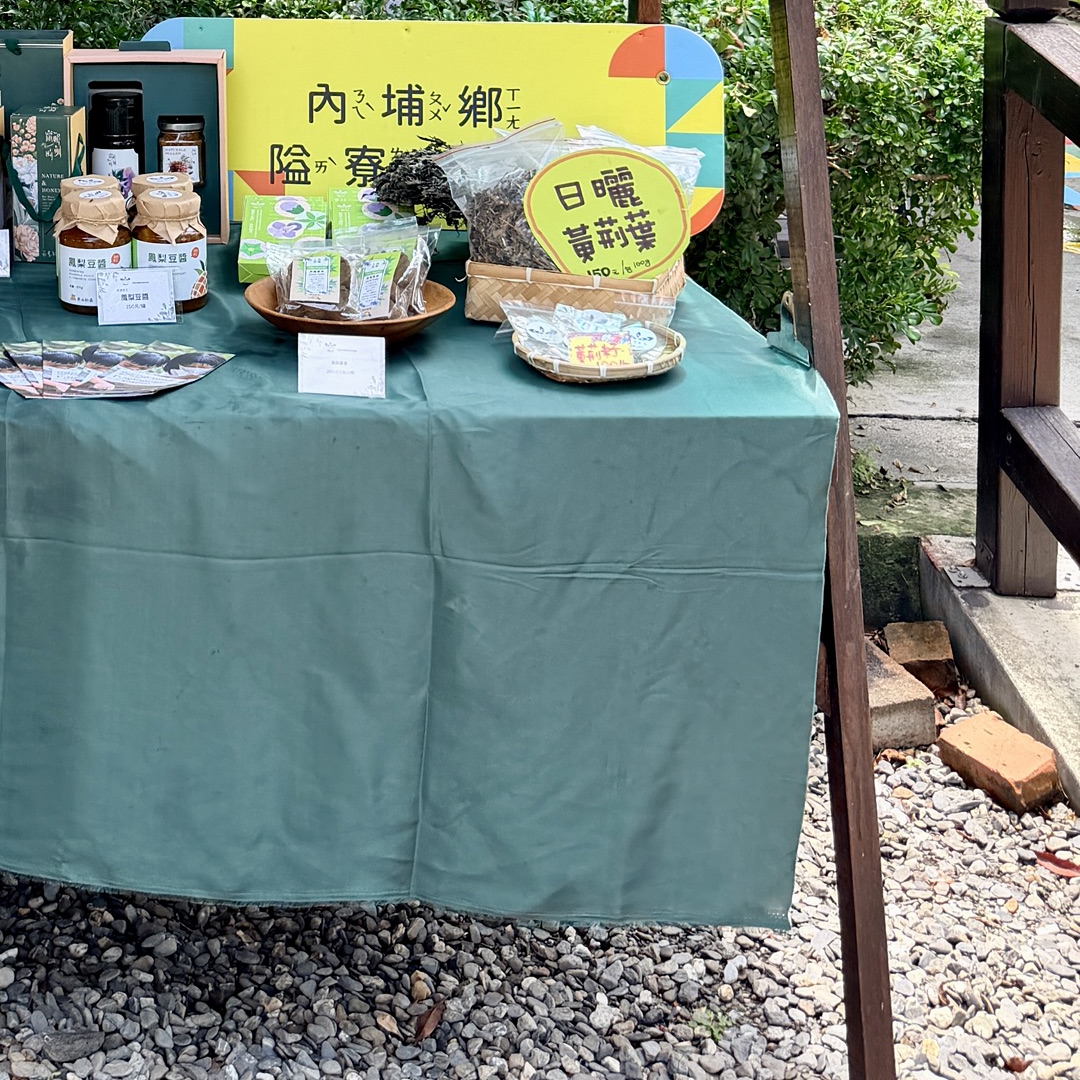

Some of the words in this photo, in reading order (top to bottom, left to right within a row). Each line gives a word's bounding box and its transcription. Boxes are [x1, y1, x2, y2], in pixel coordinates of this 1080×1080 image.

[308, 83, 503, 129] 內埔鄉
[553, 166, 644, 211] 日曬
[562, 208, 657, 264] 黃荊葉
